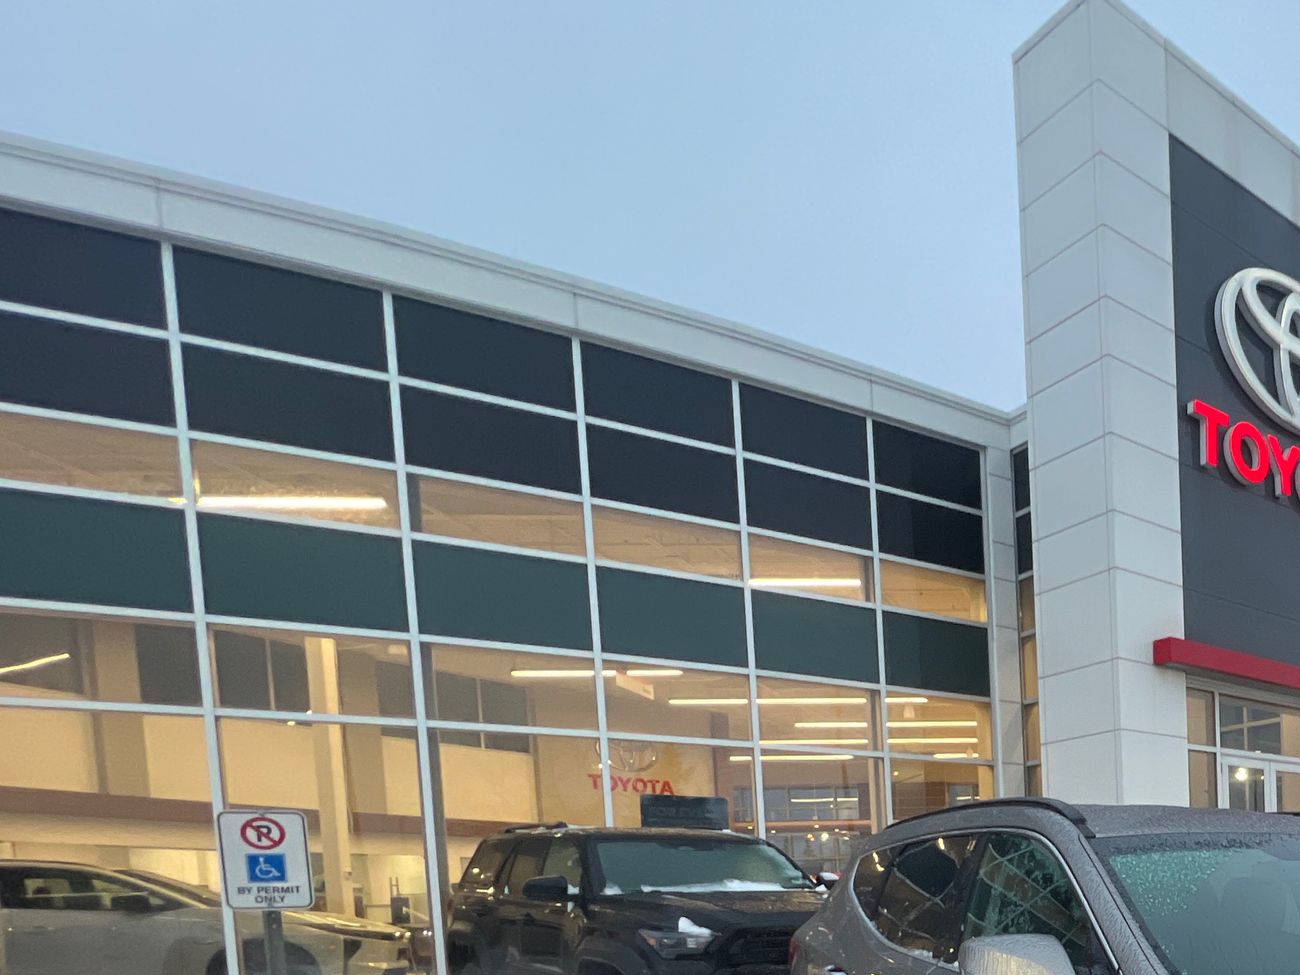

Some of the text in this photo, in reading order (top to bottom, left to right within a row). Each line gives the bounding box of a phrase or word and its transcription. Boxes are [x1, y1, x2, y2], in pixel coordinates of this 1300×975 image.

[237, 885, 301, 895] BY PERMIT
[255, 895, 286, 904] ONLY
